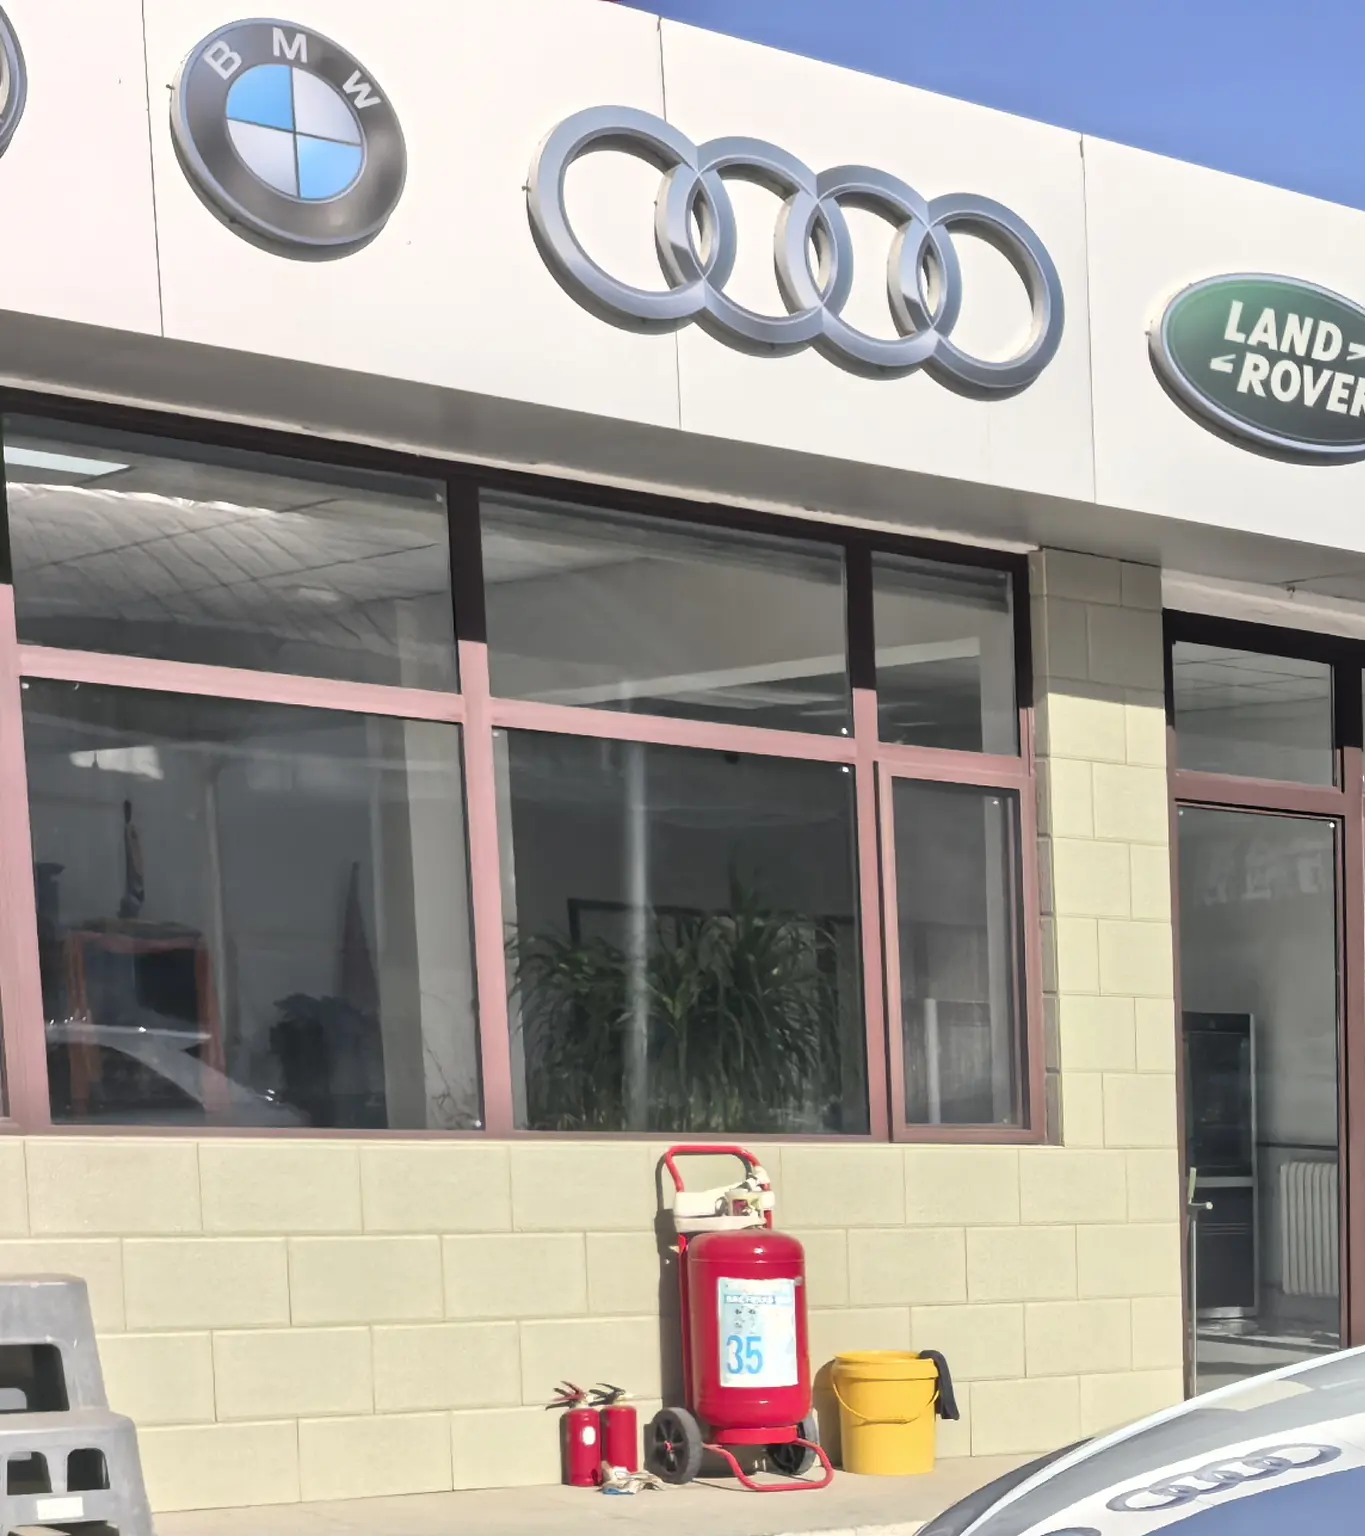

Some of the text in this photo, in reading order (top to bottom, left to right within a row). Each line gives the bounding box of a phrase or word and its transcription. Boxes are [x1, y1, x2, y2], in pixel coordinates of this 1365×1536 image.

[203, 27, 381, 109] BMW
[1224, 300, 1343, 361] LAND
[726, 1335, 763, 1375] 35
